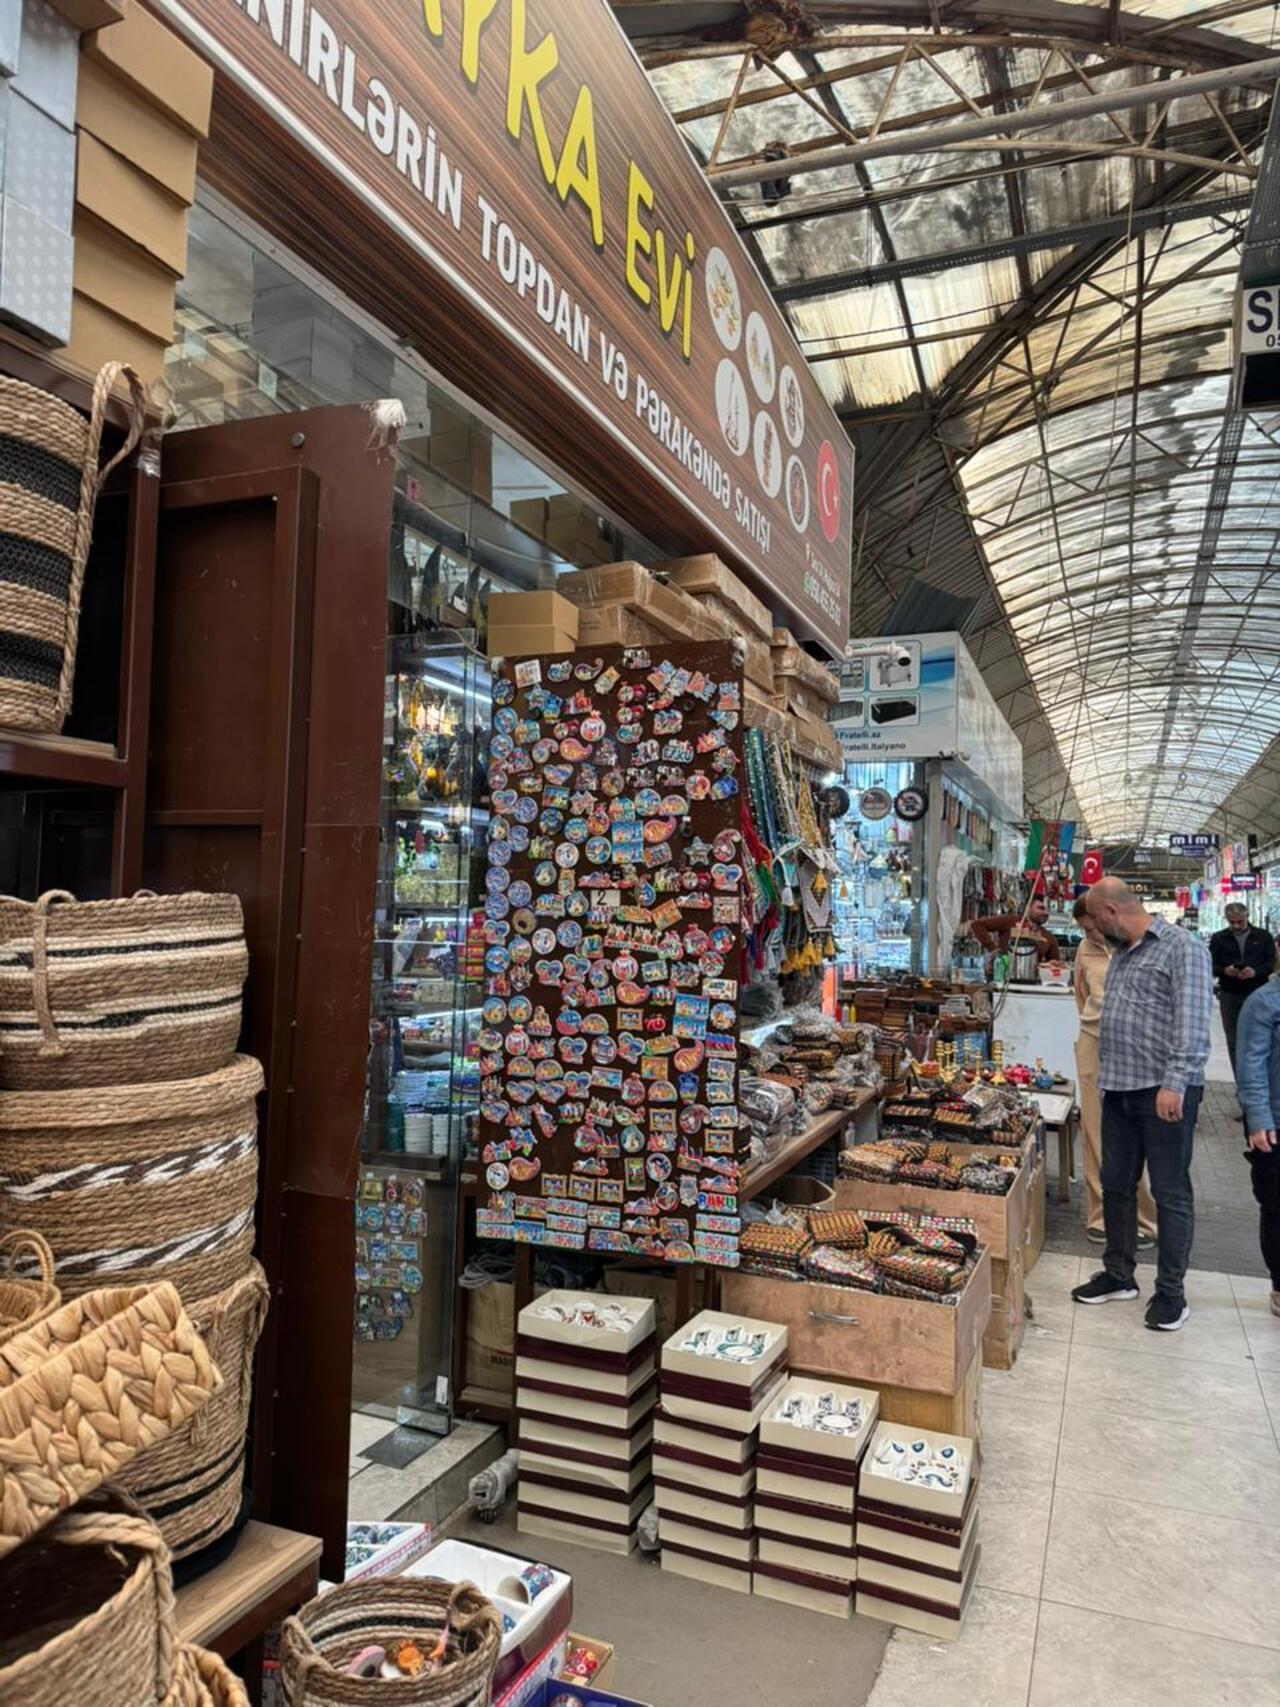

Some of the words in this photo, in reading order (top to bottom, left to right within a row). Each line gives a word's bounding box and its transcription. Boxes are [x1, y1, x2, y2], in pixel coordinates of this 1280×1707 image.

[477, 195, 589, 364] TOPDAN
[600, 331, 629, 401] VƏ
[1247, 288, 1280, 334] S
